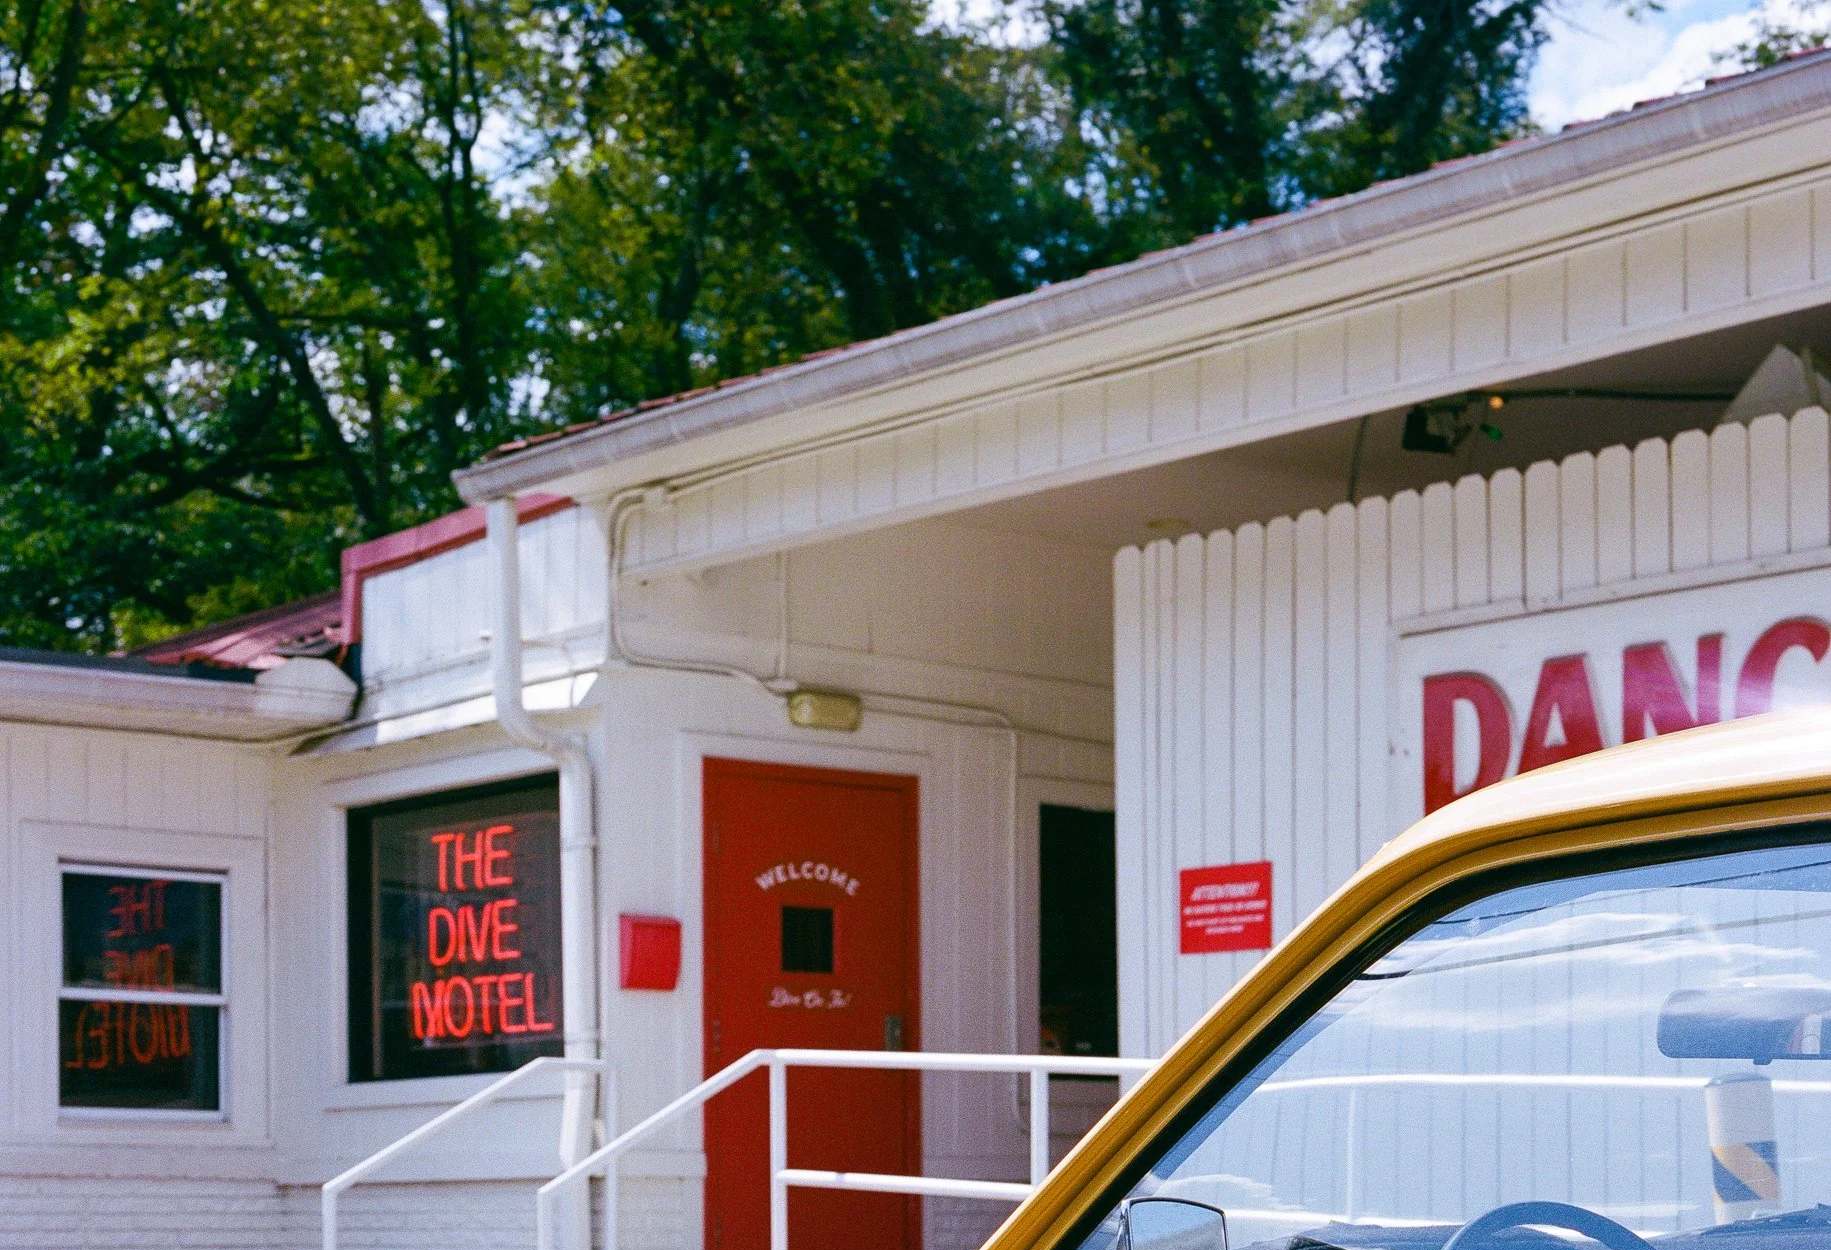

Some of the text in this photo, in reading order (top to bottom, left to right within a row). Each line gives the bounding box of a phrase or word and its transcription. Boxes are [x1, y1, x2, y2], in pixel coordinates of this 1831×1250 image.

[431, 824, 514, 892] THE
[754, 861, 861, 896] WELCOME
[428, 898, 522, 967] DIVE
[410, 972, 556, 1040] MOTEL
